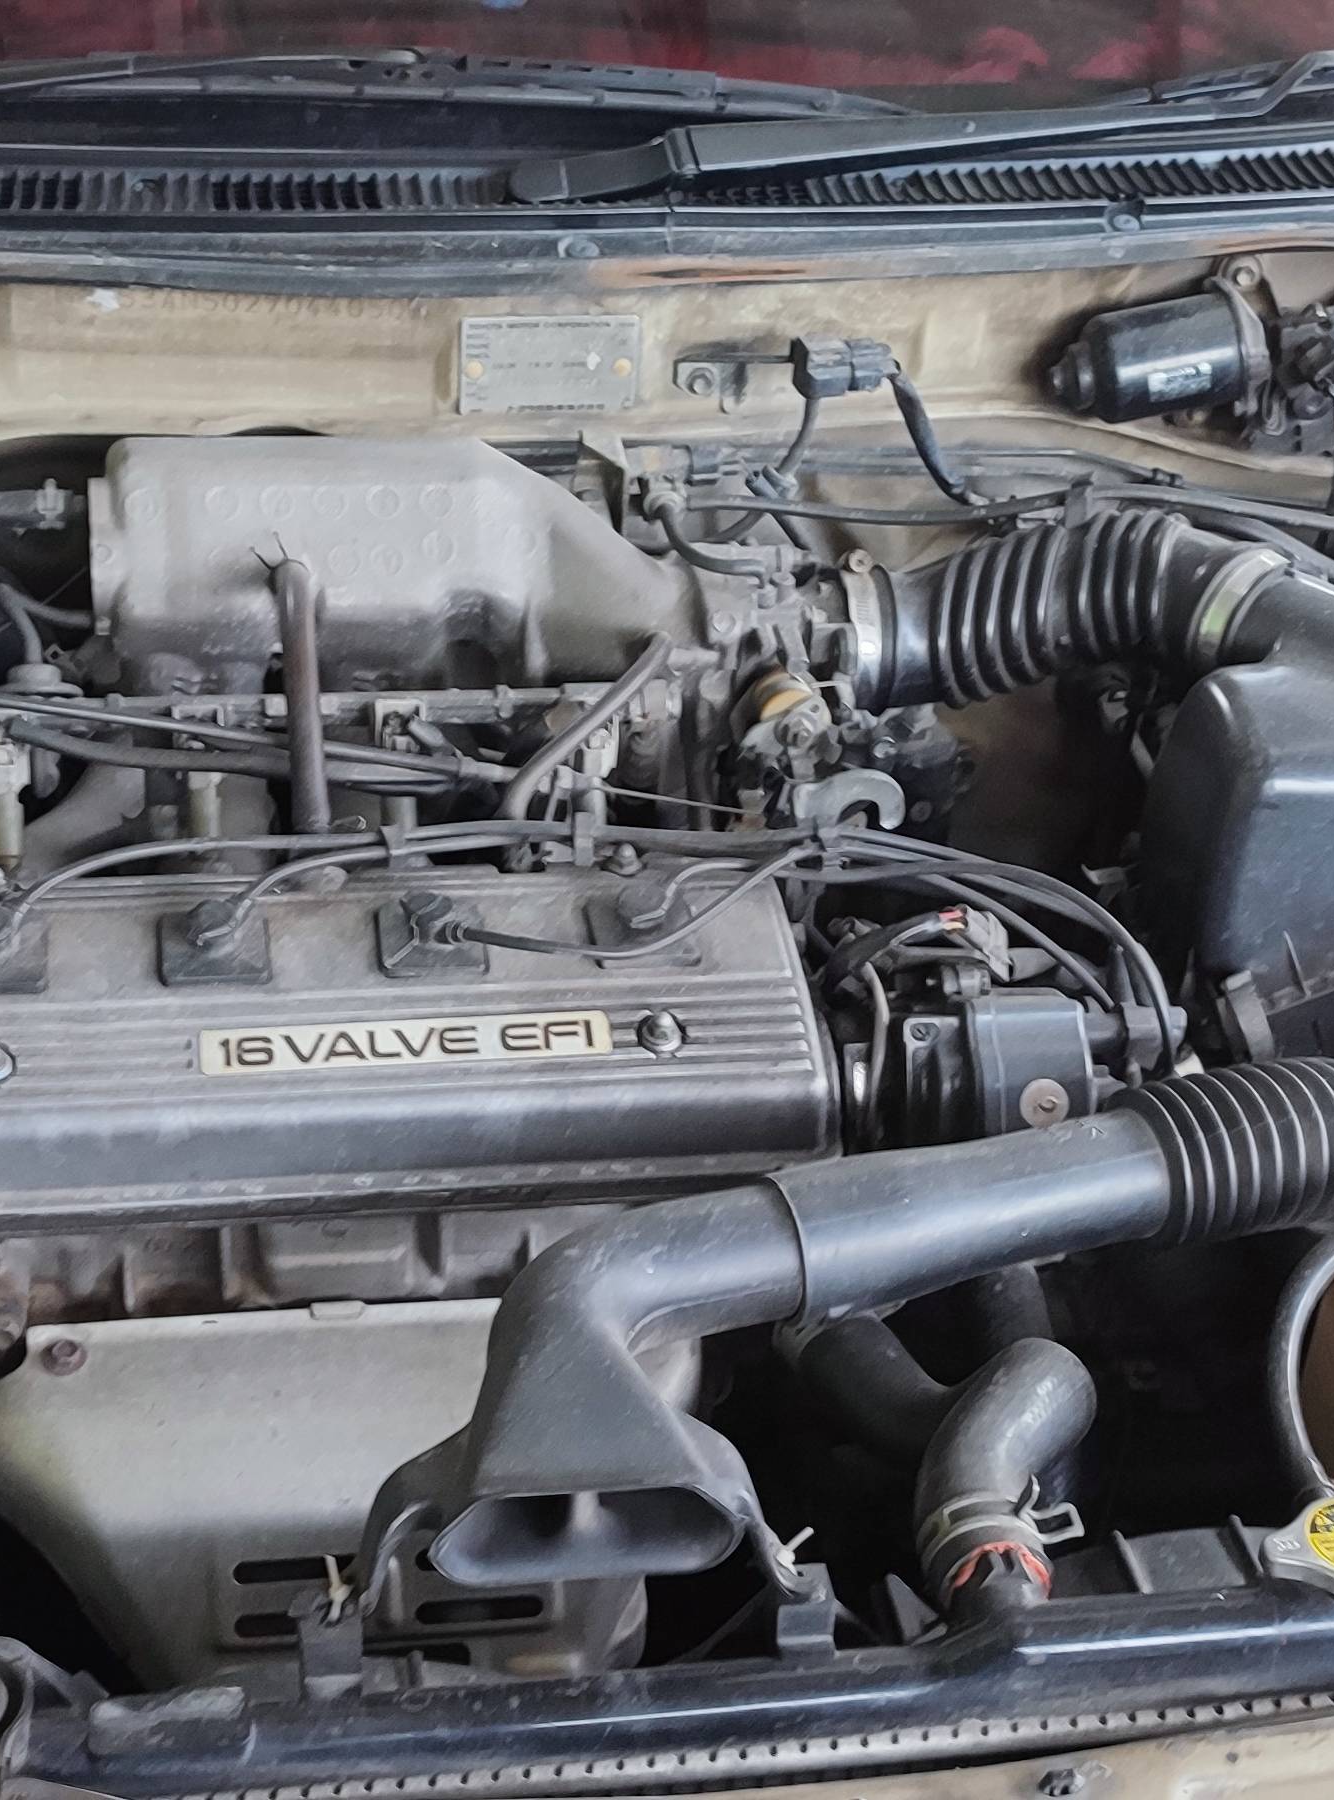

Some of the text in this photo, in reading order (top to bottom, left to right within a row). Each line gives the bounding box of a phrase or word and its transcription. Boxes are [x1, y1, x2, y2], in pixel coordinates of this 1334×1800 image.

[220, 1018, 596, 1067] 16 VALVE EFI
